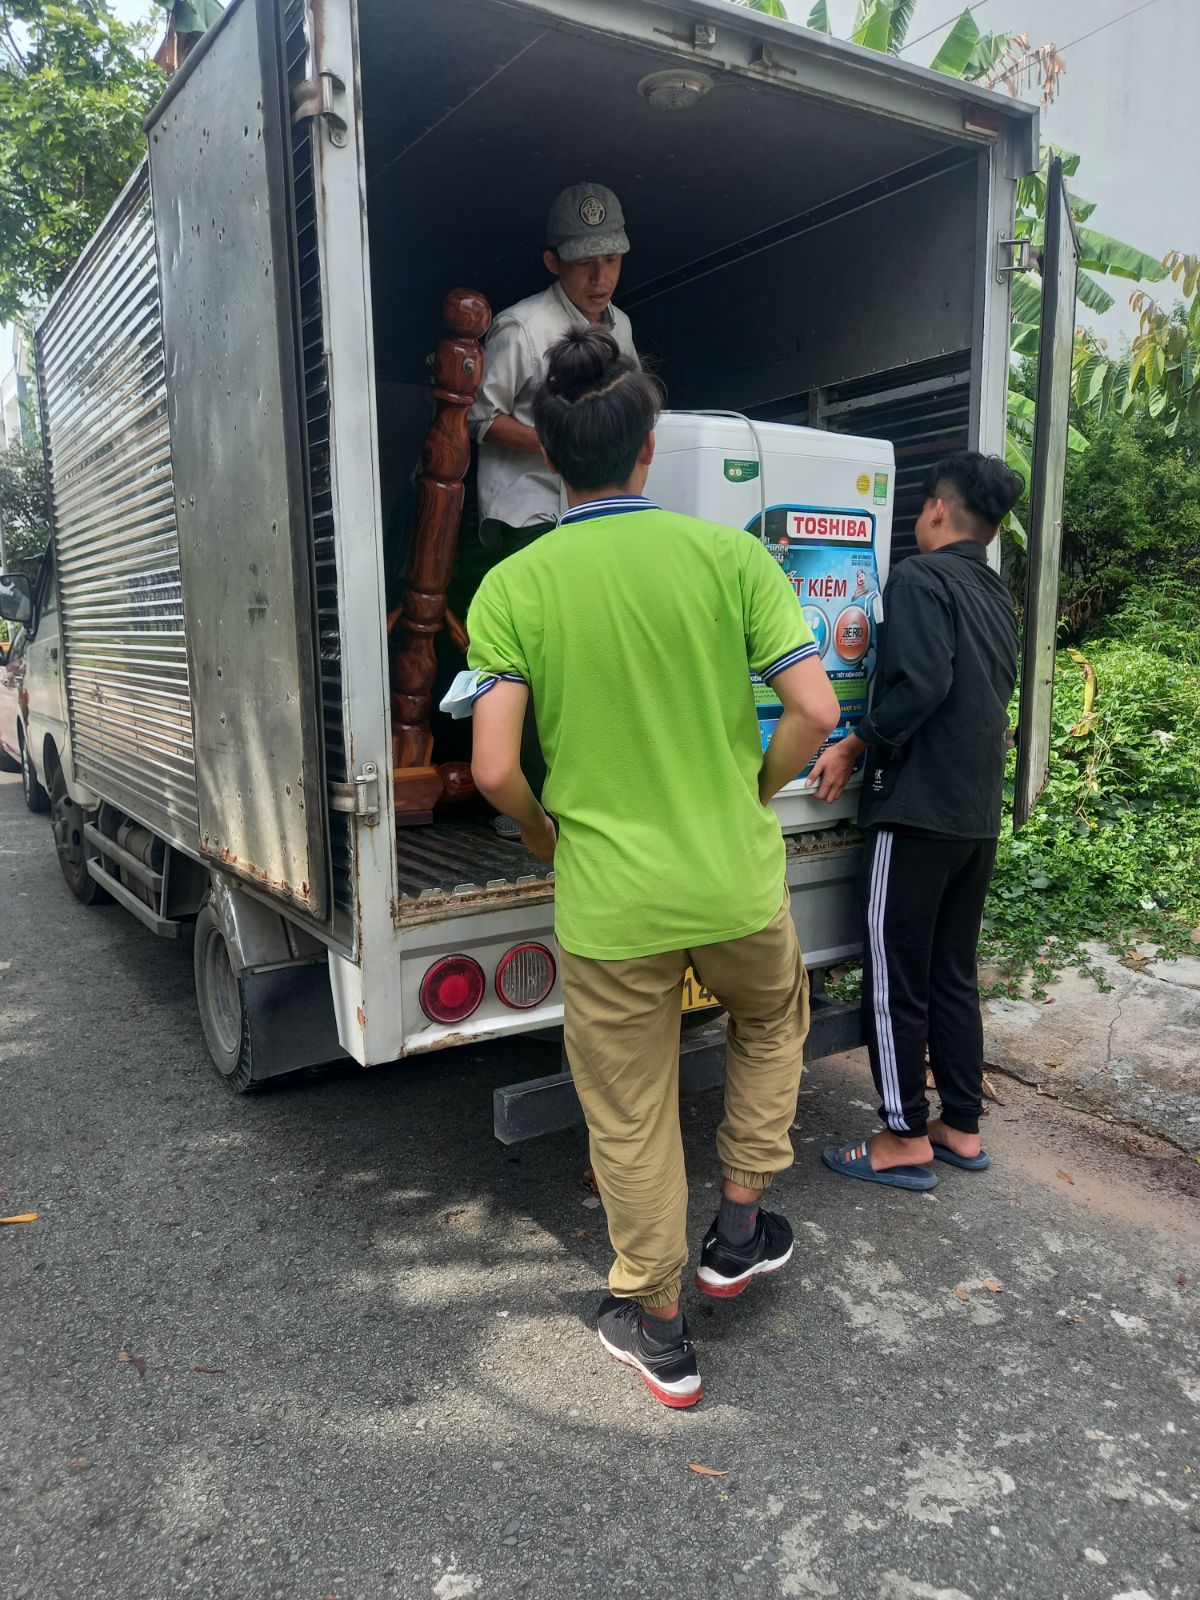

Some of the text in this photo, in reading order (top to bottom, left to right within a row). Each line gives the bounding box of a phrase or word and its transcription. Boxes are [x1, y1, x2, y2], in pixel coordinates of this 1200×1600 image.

[793, 516, 867, 538] TOSHIBA
[808, 575, 848, 602] KIỆM
[842, 627, 863, 638] ZERO
